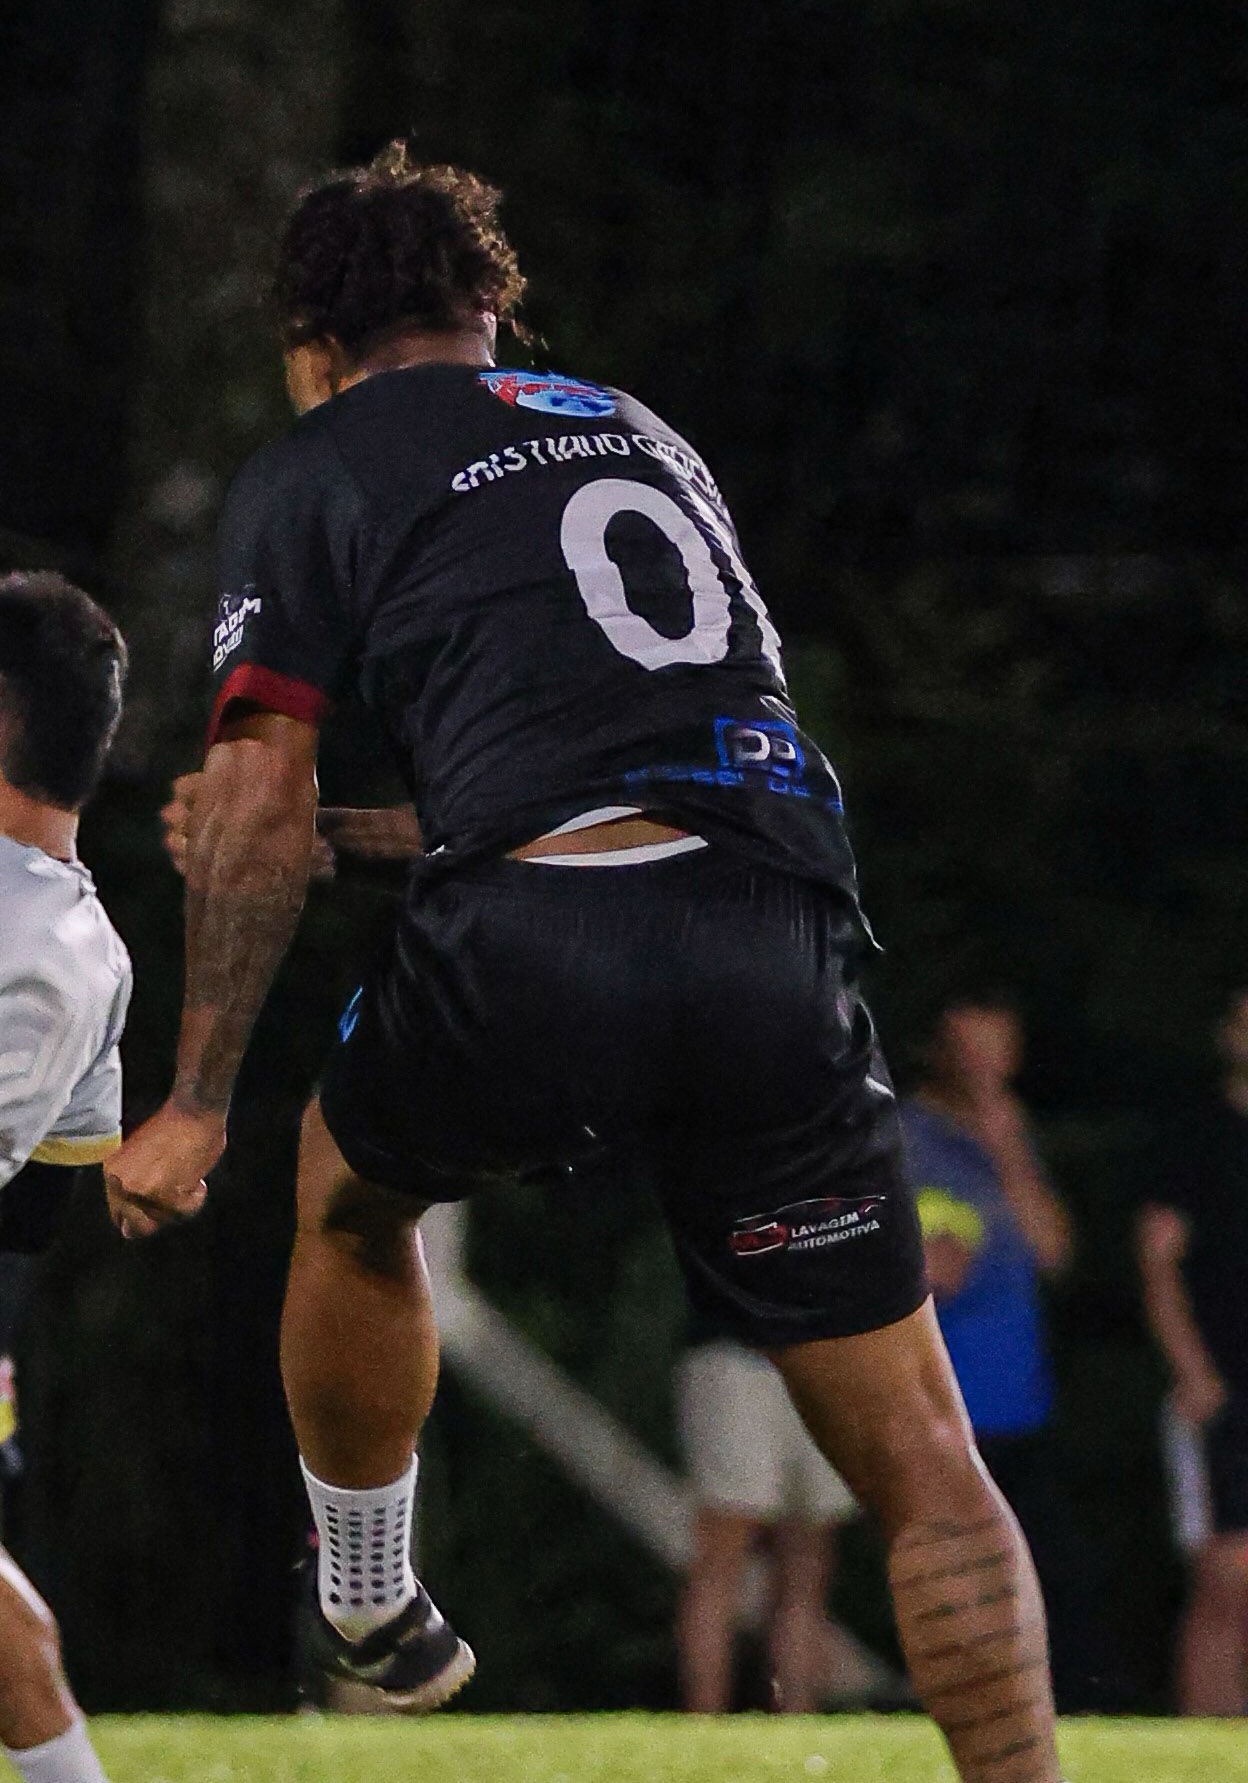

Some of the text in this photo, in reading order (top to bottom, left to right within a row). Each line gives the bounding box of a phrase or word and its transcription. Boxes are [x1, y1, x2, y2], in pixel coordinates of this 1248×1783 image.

[451, 433, 631, 492] CRISTIANO
[787, 1219, 881, 1251] AUTOMOTIVA
[791, 1211, 860, 1238] LAVAGEM
